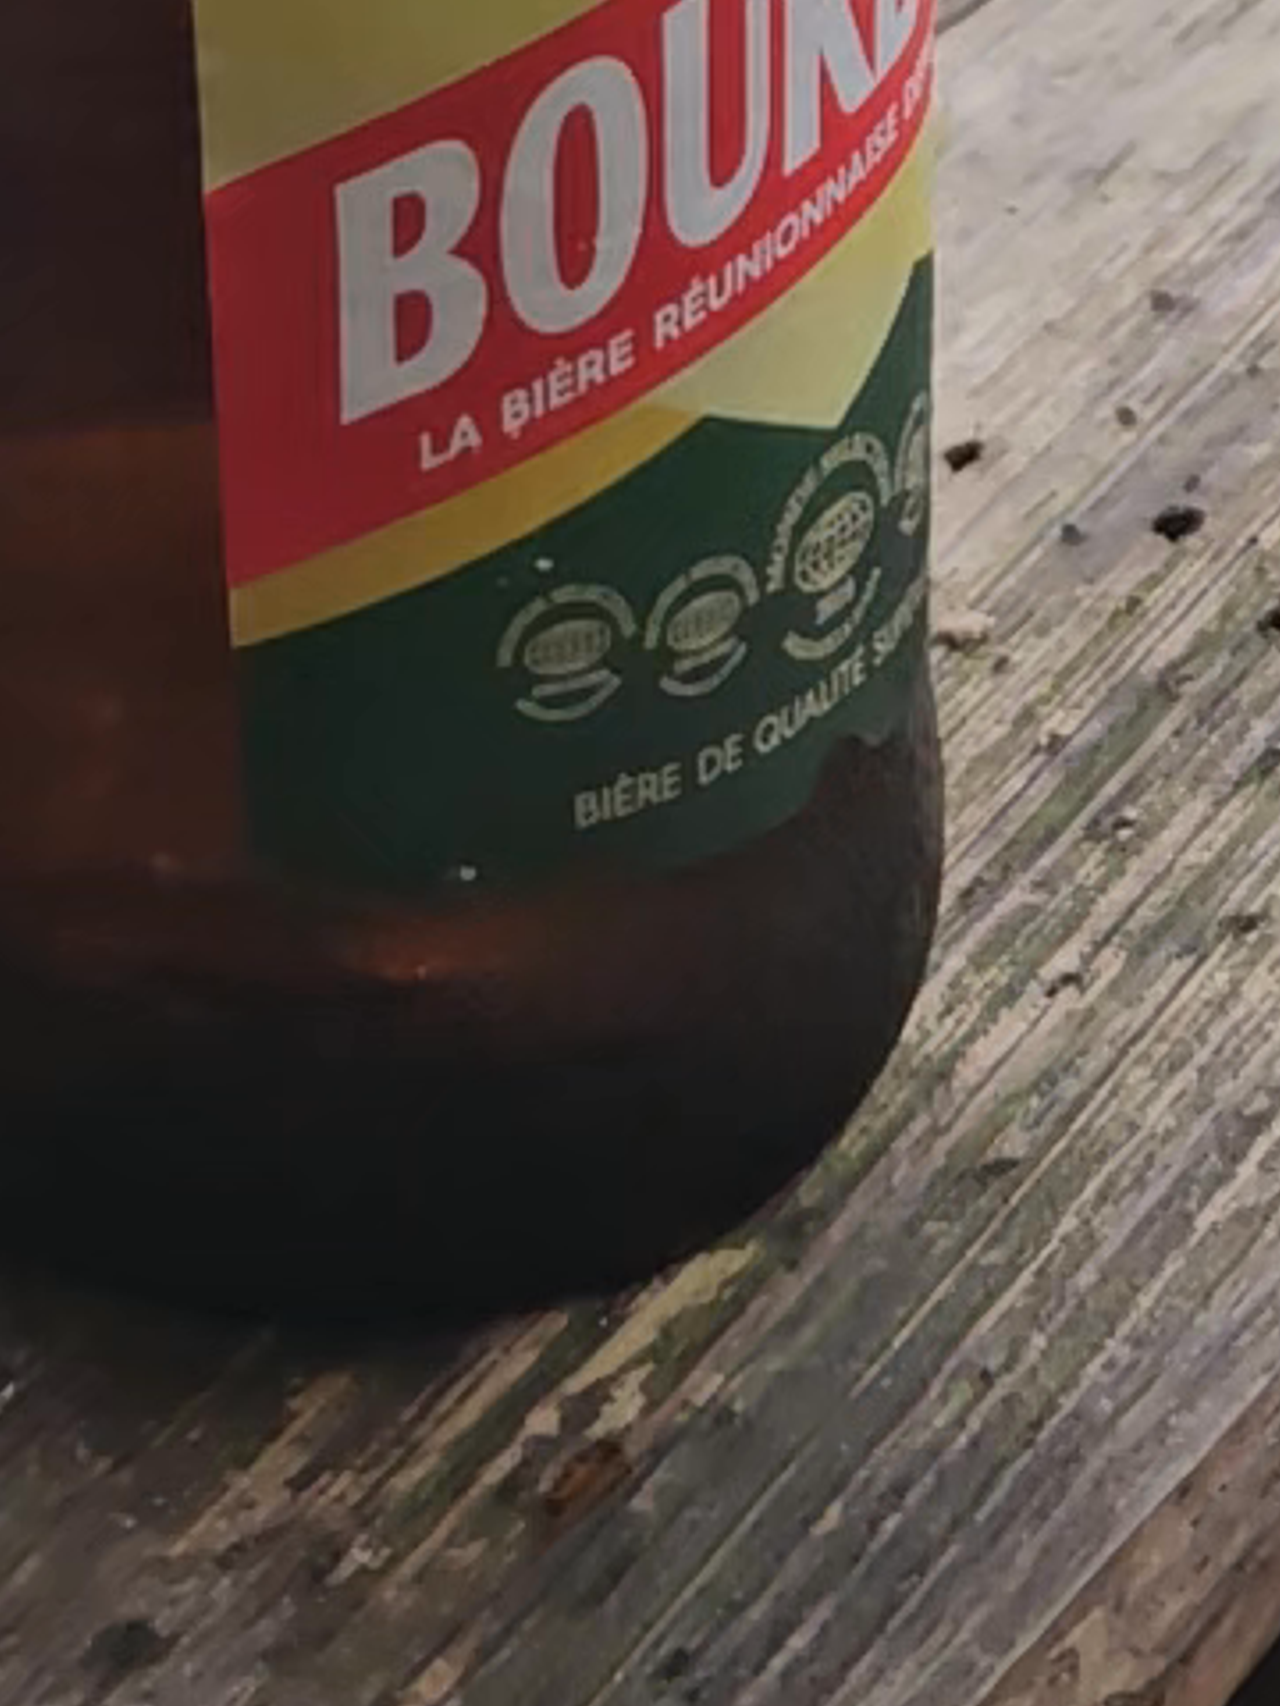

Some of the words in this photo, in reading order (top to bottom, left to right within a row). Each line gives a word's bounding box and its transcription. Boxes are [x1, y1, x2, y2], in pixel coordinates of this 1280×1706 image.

[419, 414, 483, 471] LA
[501, 327, 637, 439] BIÈRE
[652, 101, 898, 350] RÉUNIONNAISE
[572, 761, 683, 830] BIÈRE
[695, 733, 745, 788] DE
